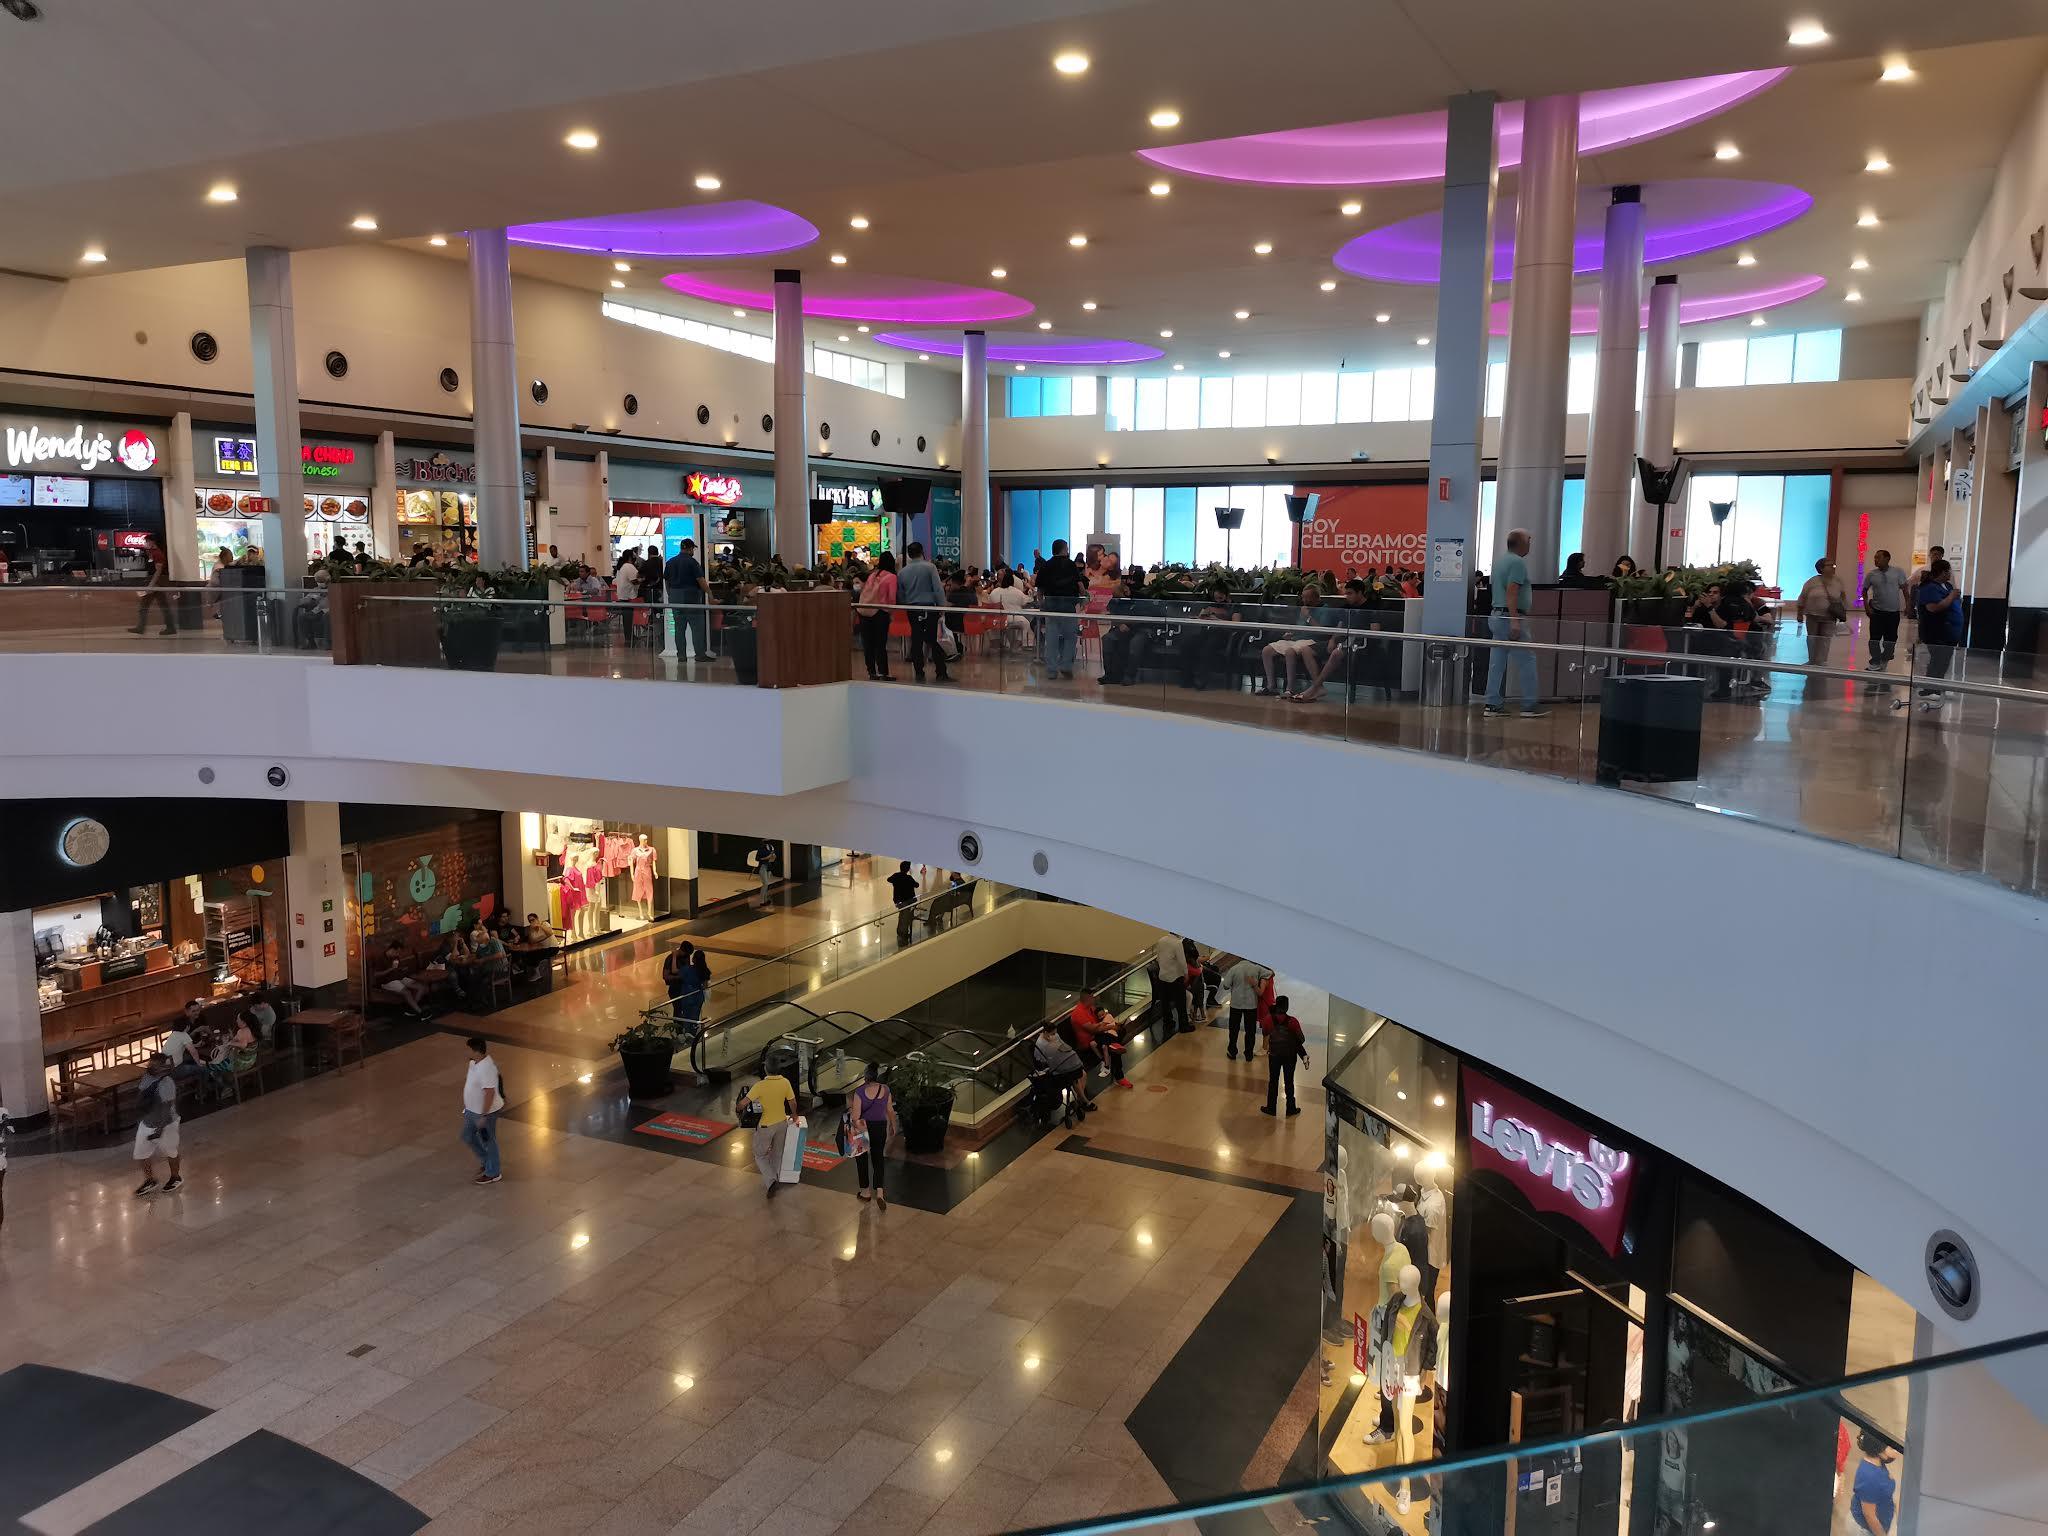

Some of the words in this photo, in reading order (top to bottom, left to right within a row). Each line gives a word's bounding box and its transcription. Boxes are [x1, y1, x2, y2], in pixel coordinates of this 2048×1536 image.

[313, 445, 355, 464] CHINA
[302, 463, 340, 476] tonesa
[413, 458, 476, 483] Bucha
[700, 476, 727, 495] Carl's
[817, 484, 847, 505] LUCKY
[847, 485, 869, 509] HEN
[881, 516, 890, 549] PIZ
[1302, 518, 1340, 533] HOY
[1302, 533, 1427, 549] CELEBRAMOS
[1340, 549, 1426, 565] CONTIGO
